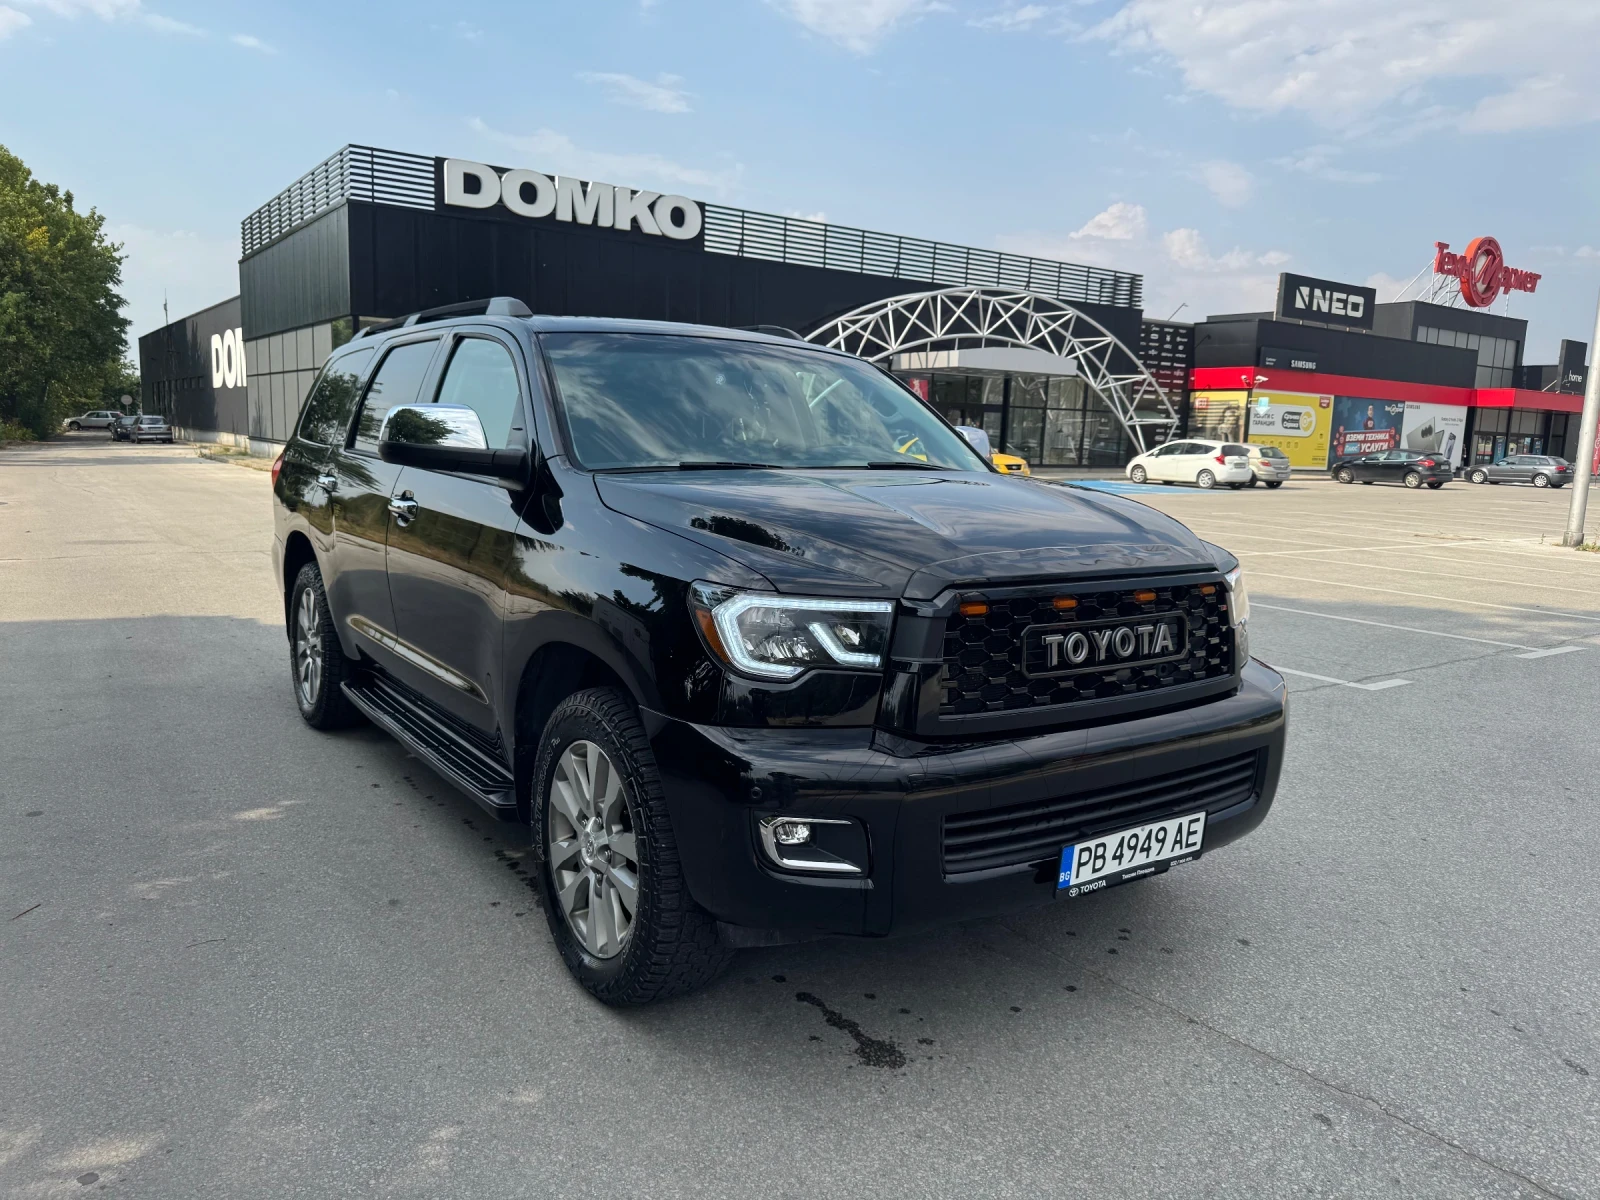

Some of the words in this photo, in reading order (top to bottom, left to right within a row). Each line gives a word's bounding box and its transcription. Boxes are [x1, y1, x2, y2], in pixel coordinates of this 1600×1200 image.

[443, 157, 702, 240] DOMKO
[1312, 287, 1365, 318] NEO
[1291, 360, 1316, 370] SAMSUNG
[1568, 370, 1583, 383] home
[1345, 433, 1365, 442] ВЗЕМИ
[1365, 432, 1389, 441] ТЕХНИКА
[1360, 442, 1389, 453] УСЛУГИ
[1042, 622, 1174, 667] TOYOTA
[1075, 842, 1107, 879] PB
[1112, 826, 1168, 867] 4949
[1171, 817, 1201, 852] AE
[1059, 871, 1071, 882] BG
[1080, 879, 1107, 894] TOYOTA
